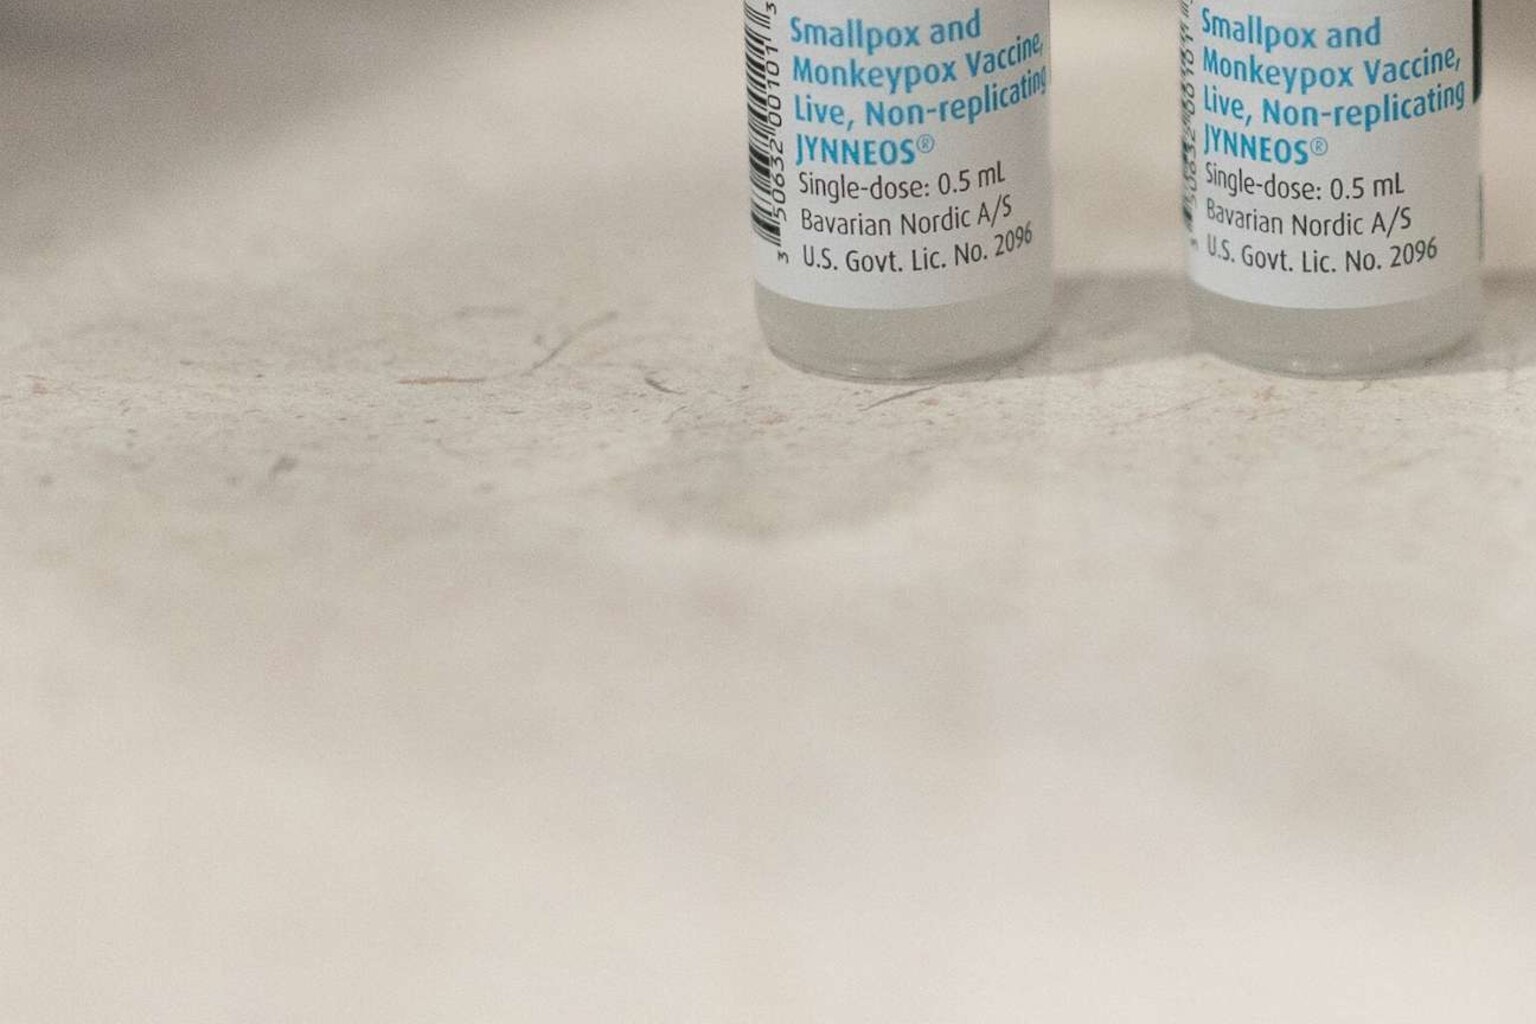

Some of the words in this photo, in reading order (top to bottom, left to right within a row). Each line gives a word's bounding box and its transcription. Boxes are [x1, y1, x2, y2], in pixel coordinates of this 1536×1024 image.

[790, 16, 919, 56] Smallpox
[930, 8, 981, 45] and
[1201, 7, 1316, 52] Smallpox
[1325, 16, 1382, 46] and
[766, 46, 783, 127] 00101
[792, 55, 957, 94] Monkeypox
[965, 31, 1044, 77] Vaccine,
[1202, 46, 1354, 94] Monkeypox
[1362, 47, 1461, 84] Vaccine,
[795, 94, 854, 131] Live,
[866, 66, 1047, 125] Non-replicating
[1203, 86, 1253, 126] Live,
[1262, 80, 1466, 131] Non-replicating
[769, 141, 788, 221] 50632
[799, 172, 930, 203] Single-dose:
[938, 170, 970, 195] 0.5
[977, 160, 1006, 187] mL
[1206, 163, 1323, 201] Single-dose:
[1330, 177, 1364, 200] 0.5
[1372, 172, 1405, 196] mL
[801, 208, 891, 235] Bavarian
[901, 207, 971, 235] Nordic
[977, 194, 1012, 228] A/S
[1206, 199, 1283, 235] Bavarian
[1292, 212, 1364, 236] Nordic
[1371, 206, 1412, 237] A/S
[803, 244, 838, 271] U.S.
[846, 249, 903, 272] Govt.
[912, 248, 947, 271] Lic.
[954, 242, 988, 264] No.
[994, 221, 1033, 257] 2096
[1207, 234, 1235, 264] U.S.
[1242, 244, 1293, 272] Govt.
[1302, 250, 1337, 273] Lic.
[1346, 250, 1382, 272] No.
[1390, 236, 1438, 267] 2096
